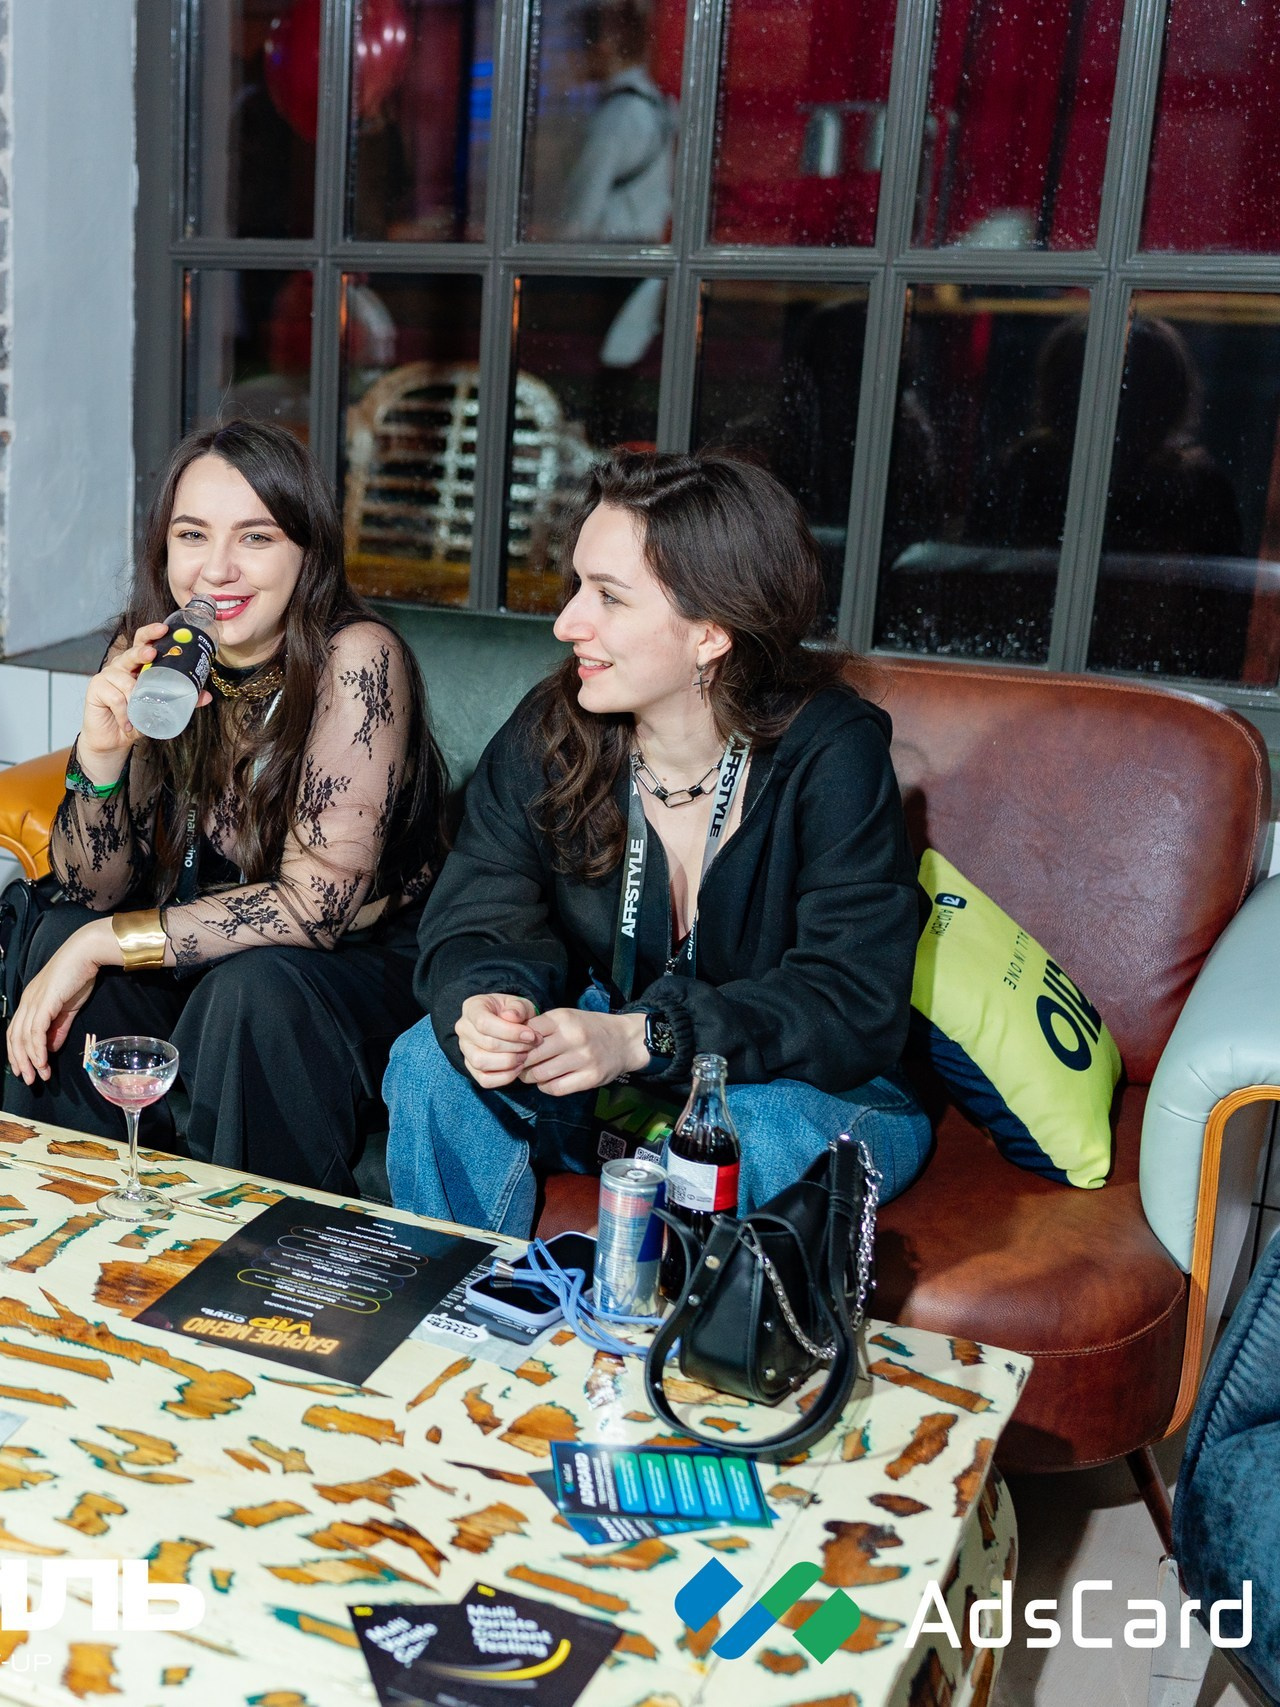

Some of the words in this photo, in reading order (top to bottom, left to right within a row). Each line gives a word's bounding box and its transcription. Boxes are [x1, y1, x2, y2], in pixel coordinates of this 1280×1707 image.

[710, 739, 746, 838] AFFSTYLE
[621, 839, 644, 938] AFFSTYLE
[1016, 930, 1029, 950] ALL
[1003, 962, 1022, 990] ONE
[182, 1317, 254, 1341] МЕНЮ
[248, 1316, 311, 1335] VIP
[427, 1319, 478, 1339] СТИЛЬ
[253, 1330, 339, 1355] БАРНОЕ
